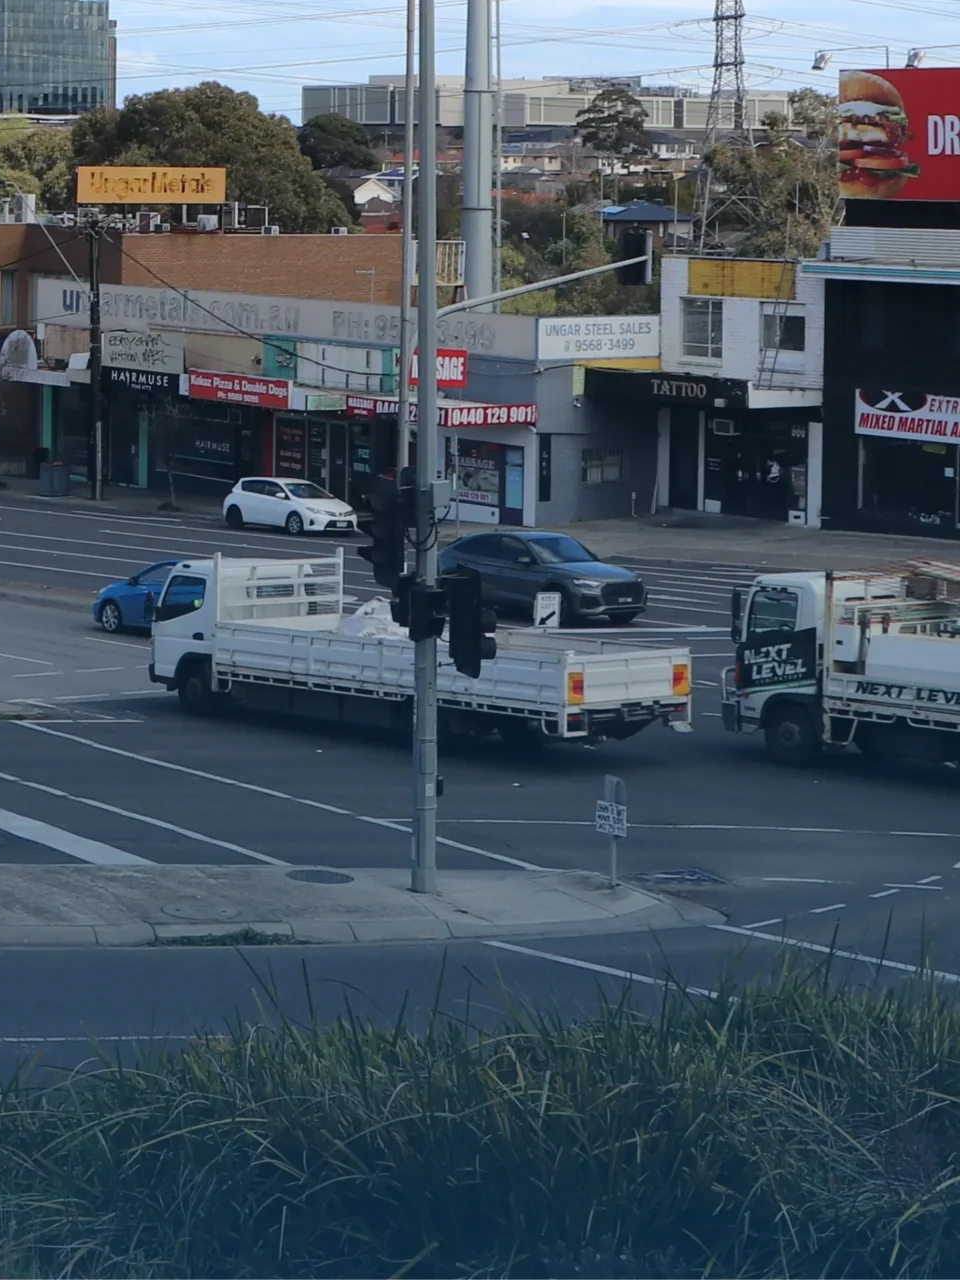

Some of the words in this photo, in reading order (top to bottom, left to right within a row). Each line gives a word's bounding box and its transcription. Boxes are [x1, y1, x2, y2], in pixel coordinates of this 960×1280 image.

[928, 115, 960, 155] DR
[90, 171, 147, 200] Ungar
[151, 171, 215, 194] Metals
[62, 288, 300, 333] unarmetals.com.au
[545, 323, 581, 337] UNGAR
[584, 322, 616, 336] STEEL
[619, 322, 652, 335] SALES
[213, 377, 232, 390] Pizza
[233, 380, 240, 391] &
[242, 381, 267, 393] Double
[268, 383, 288, 398] Dogs
[651, 379, 707, 398] TATTOO
[452, 408, 484, 426] 0440
[486, 407, 508, 424] 129
[509, 406, 532, 423] 901
[929, 398, 960, 415] EXTR
[859, 412, 896, 431] MIXED
[897, 416, 948, 437] MARTIAL
[950, 421, 960, 438] A
[195, 439, 230, 452] HAIRMUSE
[744, 643, 792, 665] NEXT
[752, 659, 807, 680] LEVEL
[855, 680, 909, 700] NEXT
